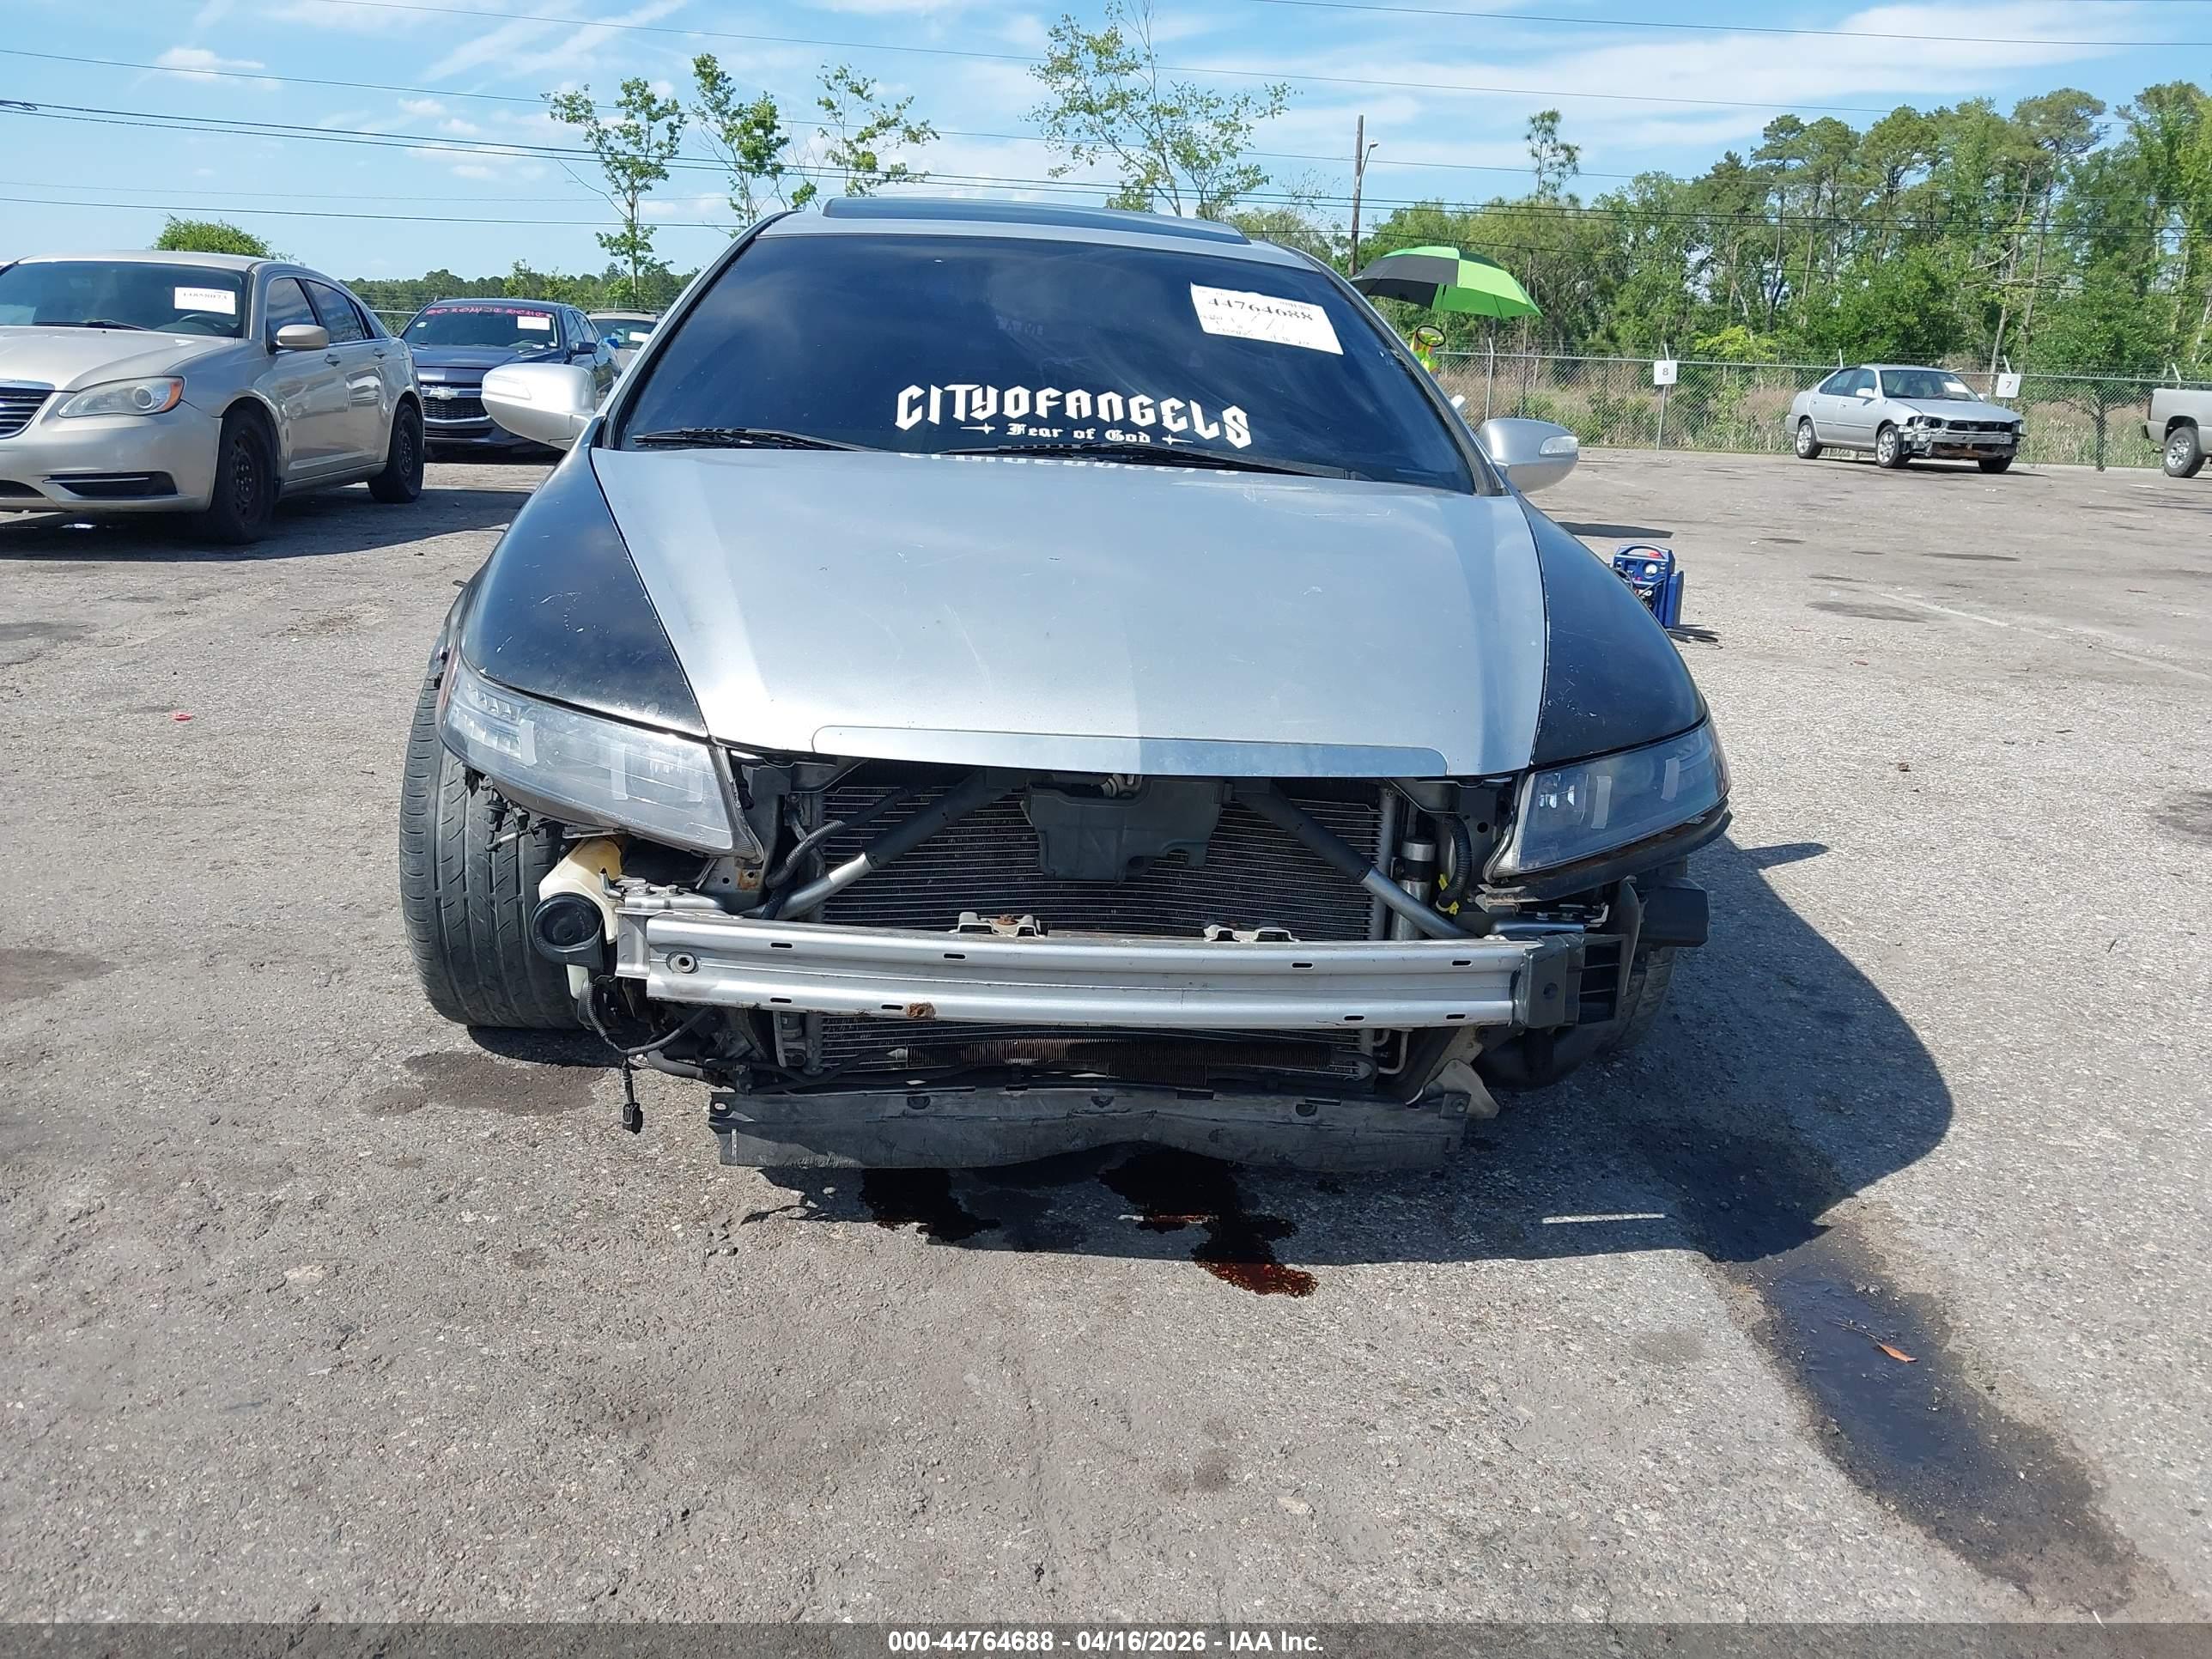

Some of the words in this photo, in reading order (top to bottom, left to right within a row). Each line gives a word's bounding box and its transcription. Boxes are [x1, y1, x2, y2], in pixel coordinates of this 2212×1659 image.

[1662, 368, 1669, 376] 8
[2005, 380, 2013, 390] 7
[1006, 422, 1063, 438] Fear
[1073, 428, 1097, 440] of
[1104, 429, 1151, 443] God
